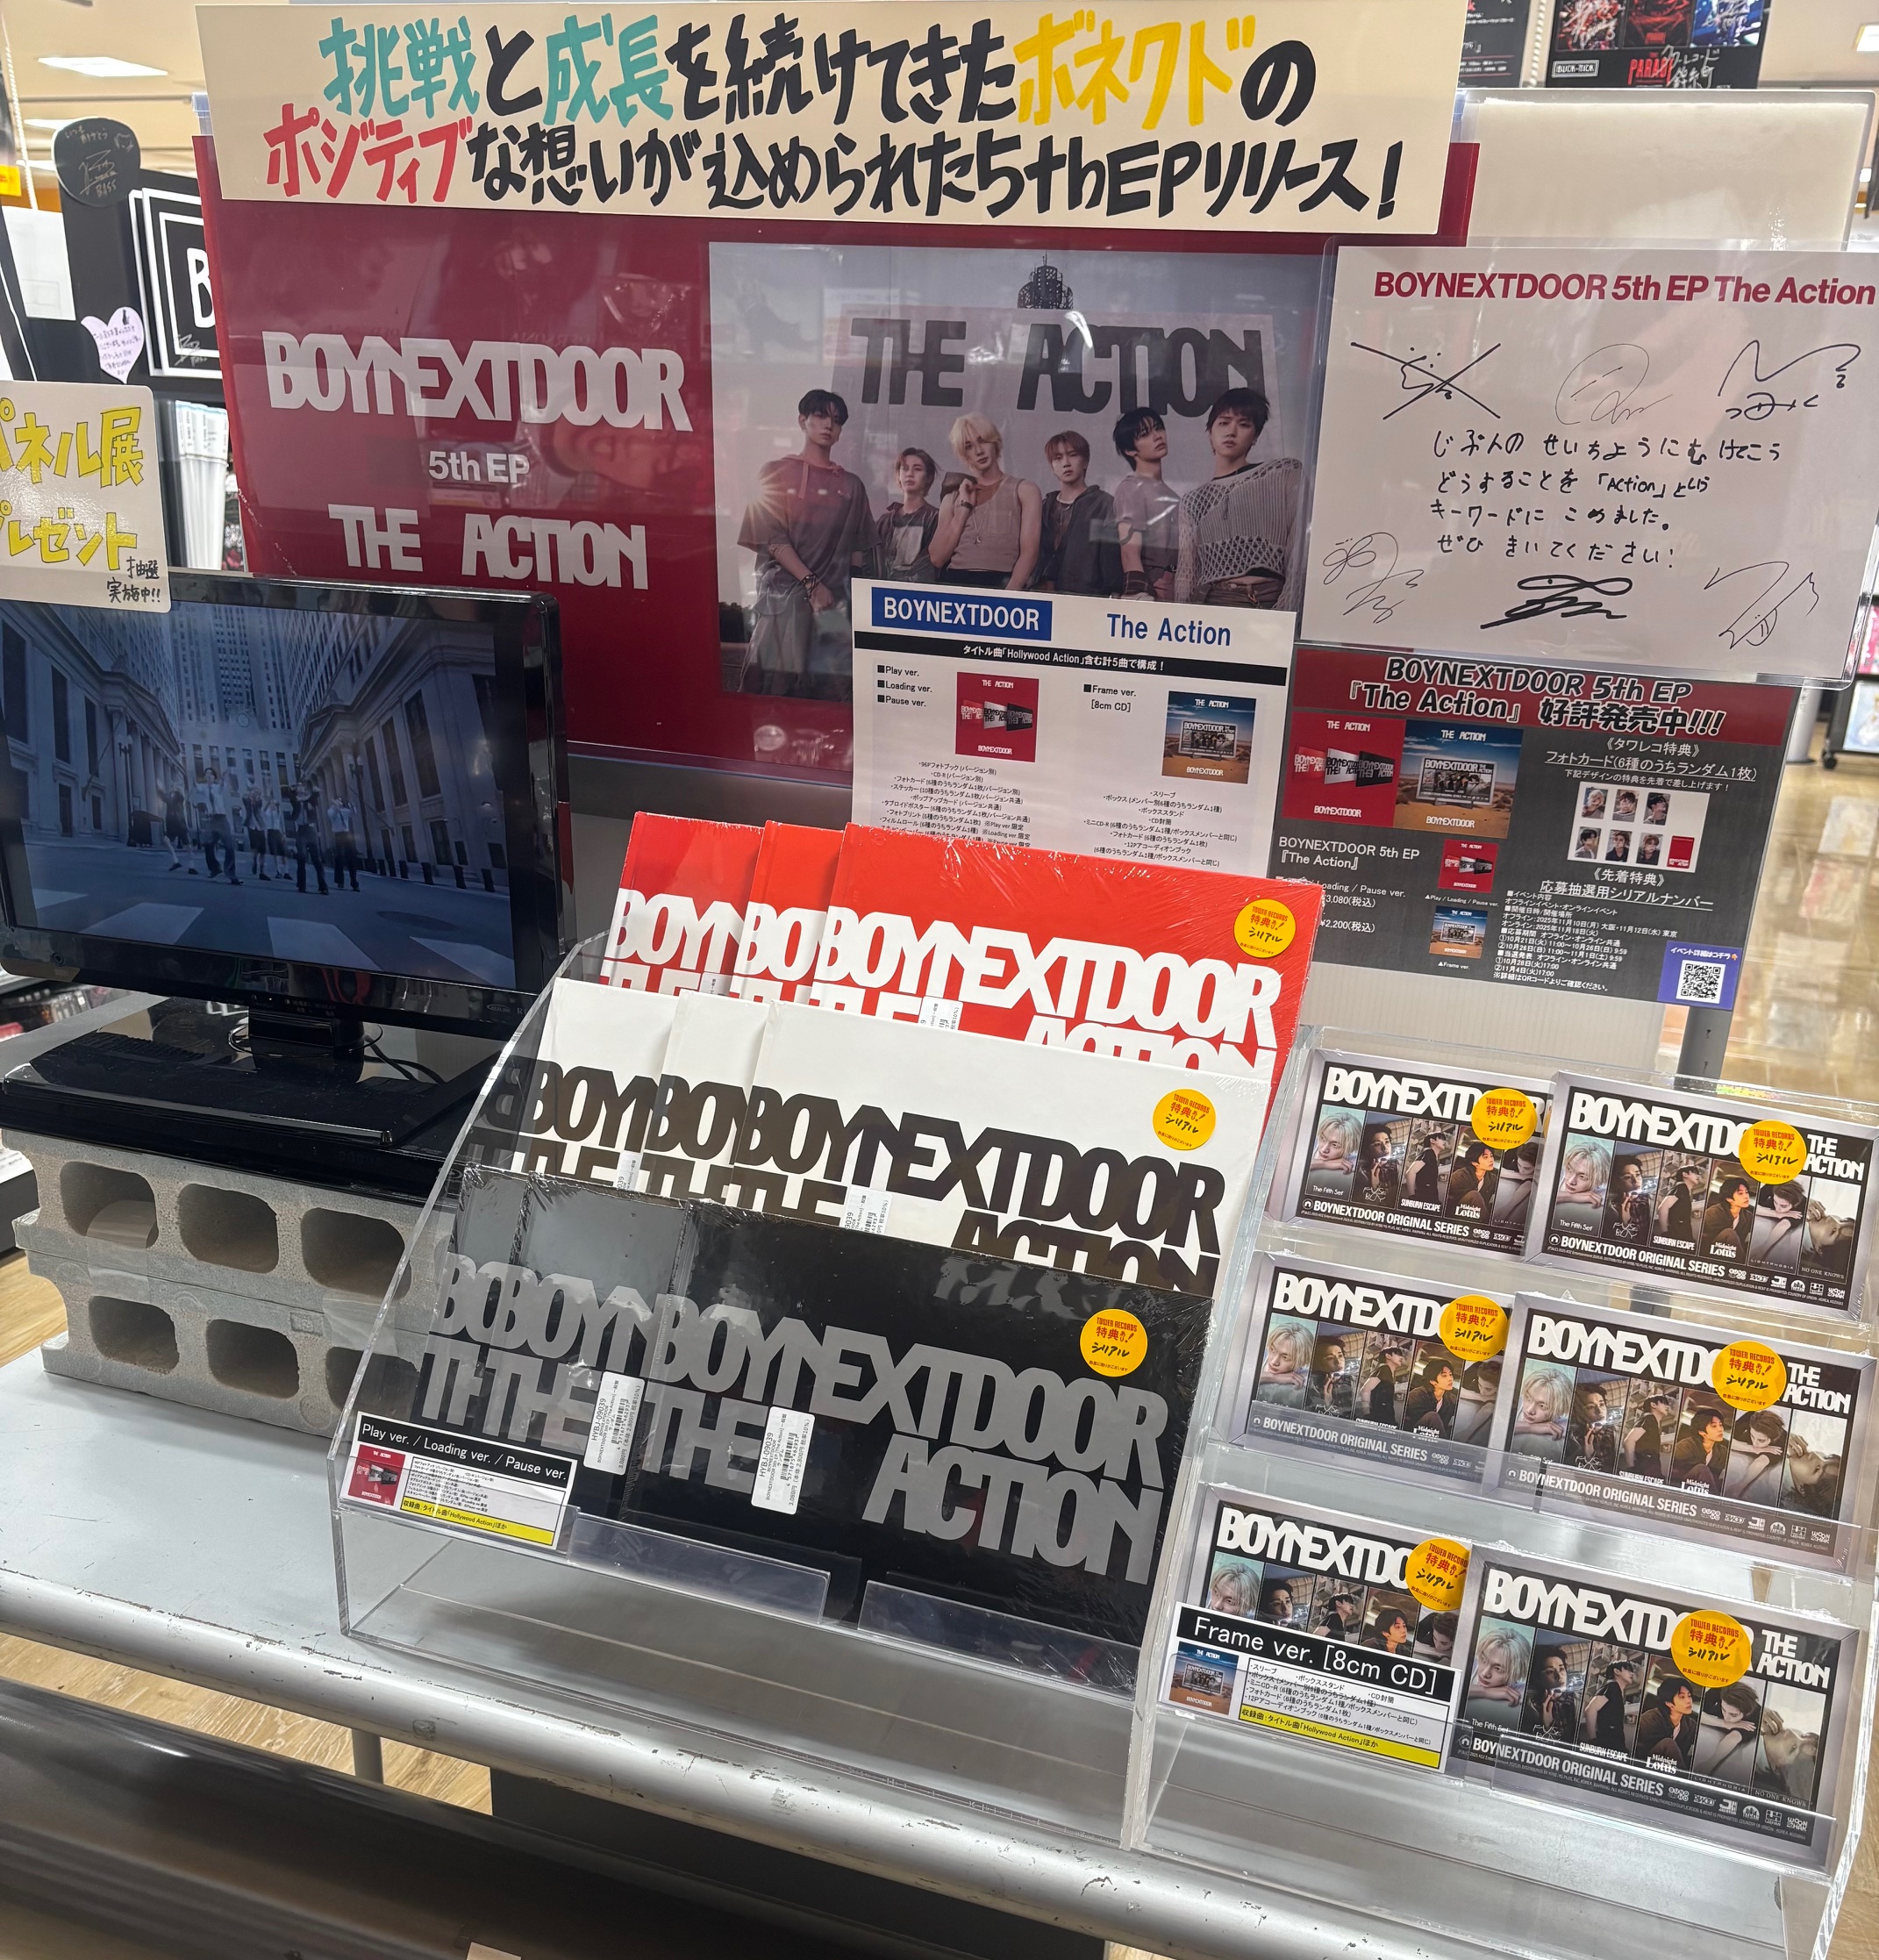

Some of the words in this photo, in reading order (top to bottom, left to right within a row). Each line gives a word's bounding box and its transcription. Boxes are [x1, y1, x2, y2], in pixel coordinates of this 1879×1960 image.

[318, 9, 1317, 131] 挑戦と成長を続けてきたボネクドの
[1374, 271, 1605, 300] BOYNEXTDOOR
[1611, 275, 1661, 300] 5th
[1667, 276, 1709, 301] EP
[1714, 280, 1770, 304] The
[1777, 282, 1875, 305] Action
[262, 331, 693, 432] BOYNEXTDOOR
[850, 318, 966, 407] THE
[1017, 322, 1264, 418] ACTION
[429, 451, 480, 482] 5th
[488, 453, 529, 483] EP
[328, 504, 423, 571] THE
[462, 513, 648, 590] ACTION
[126, 556, 160, 579] 抽選
[884, 597, 1040, 631] BOYNEXTDOOR
[1107, 613, 1147, 640] The
[1158, 618, 1231, 646] Action
[885, 666, 903, 676] Play
[885, 681, 916, 692] Loading
[918, 684, 932, 693] ver.
[1385, 657, 1590, 697] BOYNEXTDOOR
[1591, 677, 1643, 701] 5th
[1650, 681, 1692, 704] EP
[885, 696, 910, 705] Pause
[1091, 699, 1111, 711] [8cm
[1114, 702, 1131, 712] CD]
[1092, 685, 1118, 696] Frame
[1326, 720, 1340, 730] THE
[1441, 730, 1454, 740] THE
[1279, 837, 1375, 856] BOYNEXTDOOR
[1380, 847, 1398, 858] 5th
[1403, 848, 1420, 860] EP
[1360, 884, 1386, 896] Pause
[1390, 889, 1405, 898] ver.
[813, 905, 1282, 1049] BOYNEXTDOOR
[1323, 1067, 1545, 1138] BOYNEXTD
[1807, 1134, 1838, 1156] THE
[735, 1085, 1225, 1255] BOYNEXTDOOR
[1803, 1154, 1865, 1181] ACTION
[1313, 1200, 1385, 1224] BOYNEXTDOOR
[1387, 1212, 1432, 1232] ORIGINAL
[1434, 1221, 1469, 1237] SERIES
[1561, 1235, 1638, 1261] BOYNEXTDOOR
[1639, 1250, 1686, 1270] ORIGINAL
[1689, 1261, 1725, 1277] SERIES
[1092, 1342, 1130, 1357] シリアル
[648, 1293, 1168, 1489] BOYNEXTDOOR
[1788, 1363, 1821, 1386] THE
[1787, 1384, 1851, 1414] ACTION
[592, 1398, 606, 1441] HYBJ-09039
[362, 1423, 385, 1441] Play
[389, 1432, 410, 1445] ver.
[425, 1438, 468, 1460] Loading
[471, 1451, 490, 1463] ver.
[505, 1456, 541, 1475] Pause
[545, 1467, 567, 1480] ver.
[760, 1433, 773, 1477] HYBJ-09039
[861, 1433, 1163, 1584] ACTION
[1194, 1616, 1264, 1651] Frame
[1274, 1641, 1314, 1663] ver.
[1323, 1644, 1381, 1680] [8cm
[1390, 1663, 1438, 1695] CD]
[1761, 1628, 1798, 1658] THE
[1757, 1654, 1830, 1688] ACTION
[1474, 1737, 1560, 1770] BOYNEXTDOOR
[1562, 1760, 1618, 1789] ORIGINAL
[1621, 1776, 1663, 1796] SERIES
